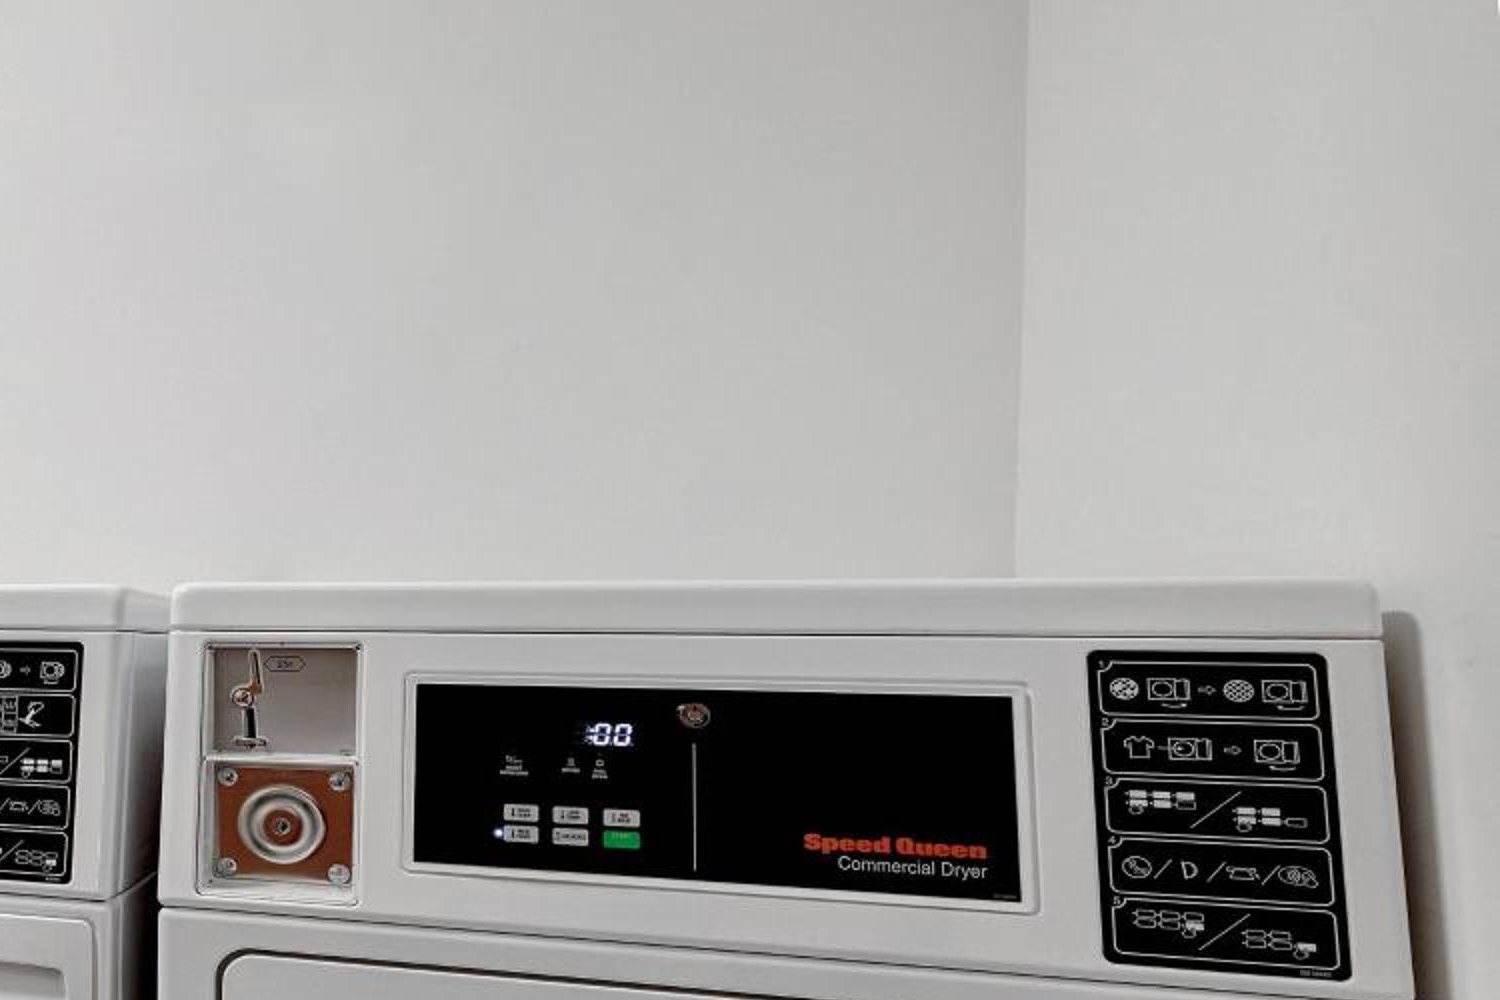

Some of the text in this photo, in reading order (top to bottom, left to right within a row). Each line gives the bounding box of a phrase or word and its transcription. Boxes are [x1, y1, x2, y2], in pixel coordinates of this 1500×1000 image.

[804, 833, 987, 859] Speed Queen
[837, 855, 989, 881] Commercial Dryer
